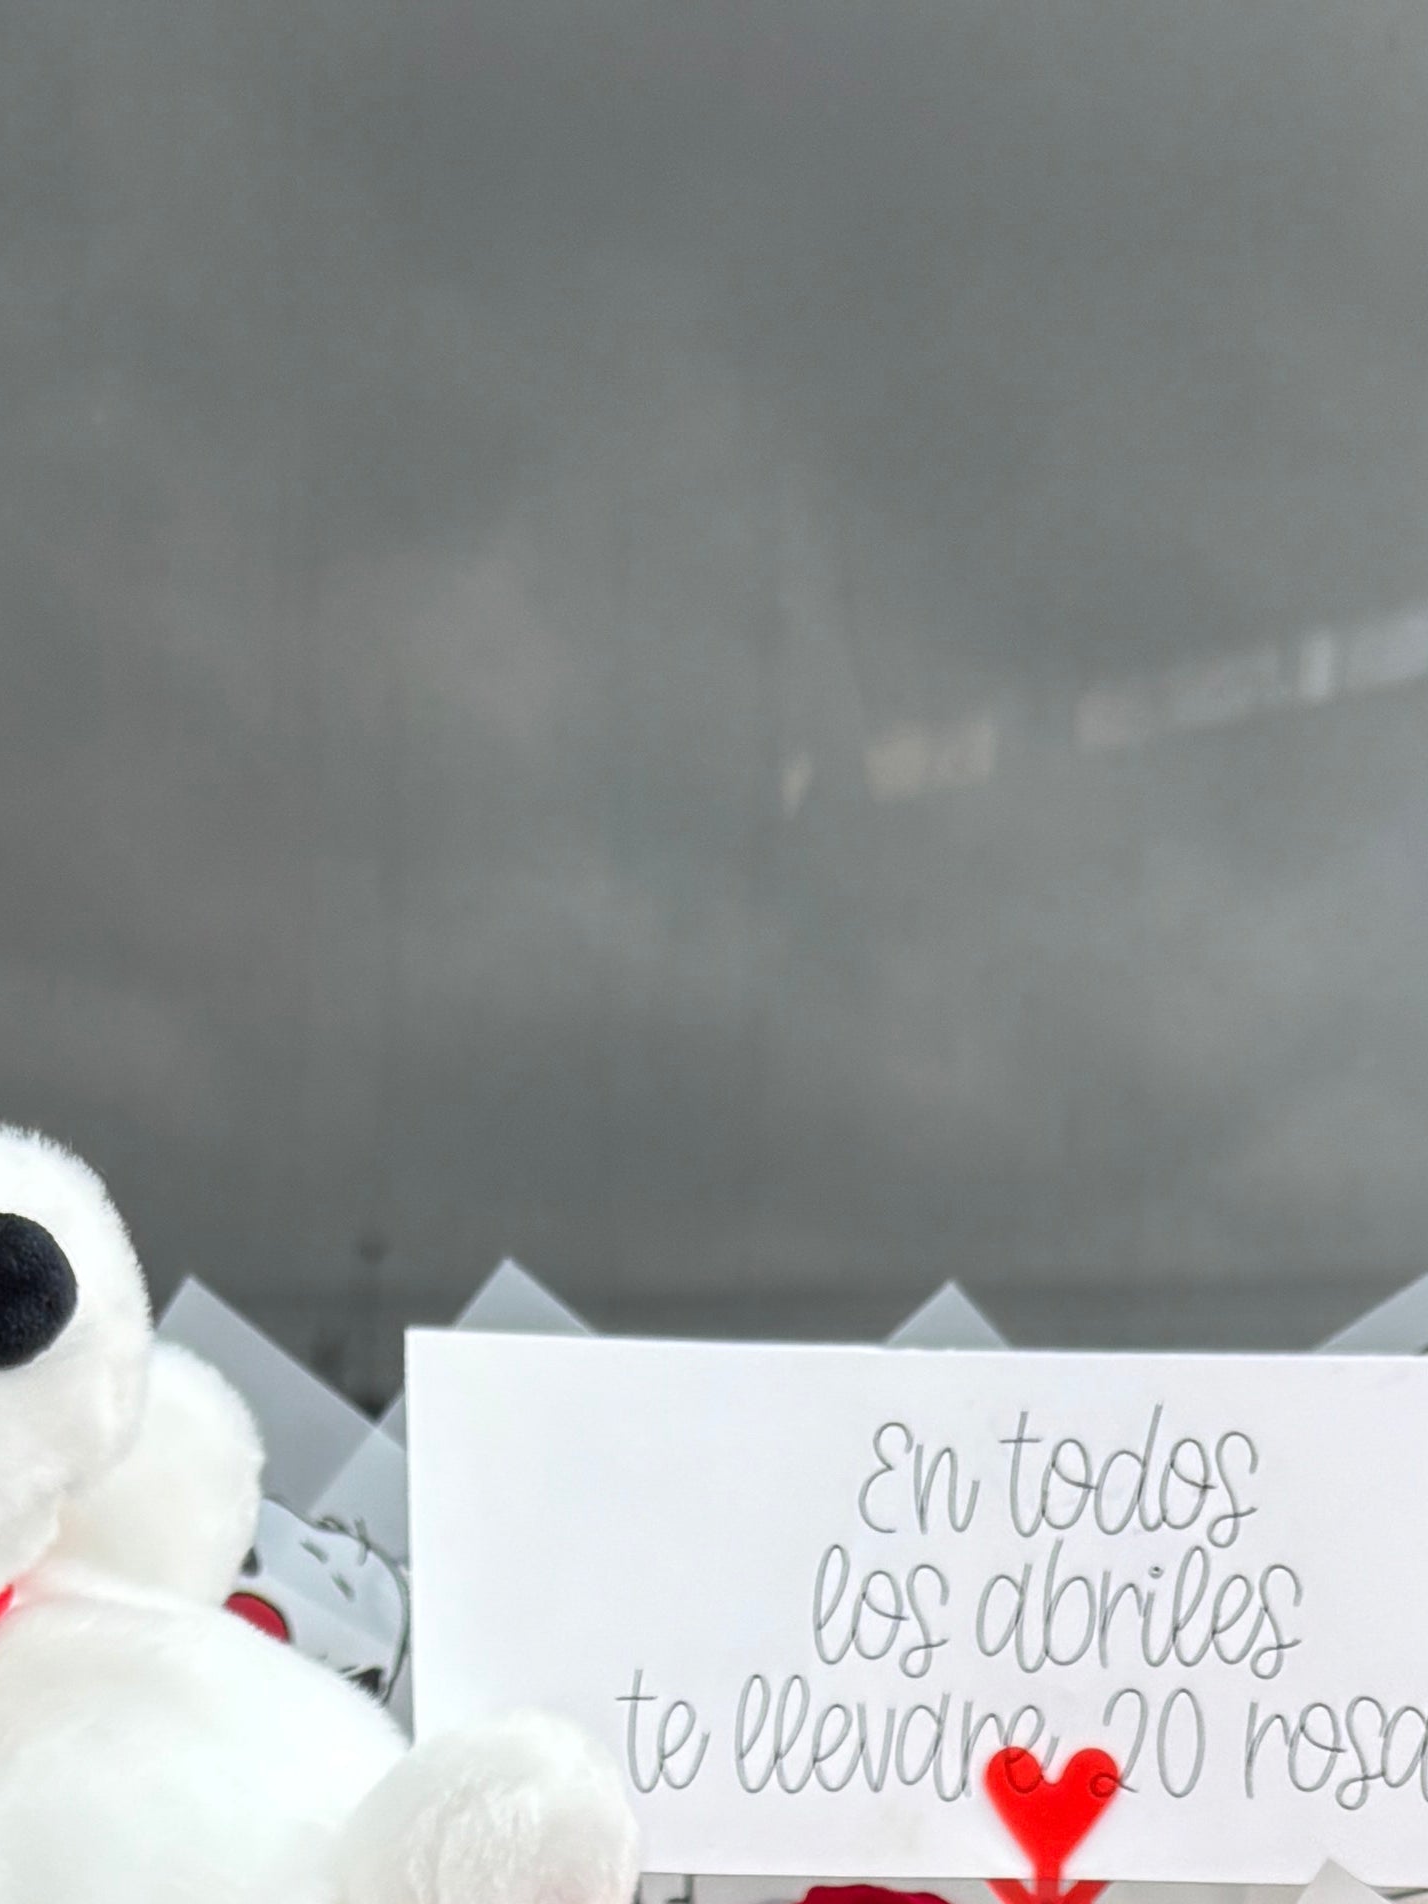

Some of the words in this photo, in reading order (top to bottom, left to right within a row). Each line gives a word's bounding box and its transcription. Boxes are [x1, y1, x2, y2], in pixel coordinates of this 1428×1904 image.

[858, 1421, 980, 1536] En
[999, 1404, 1260, 1549] todos
[813, 1544, 951, 1679] los
[976, 1538, 1304, 1680] abriles
[615, 1669, 712, 1795] te
[735, 1674, 1060, 1802] llevare
[1089, 1687, 1206, 1799] 20
